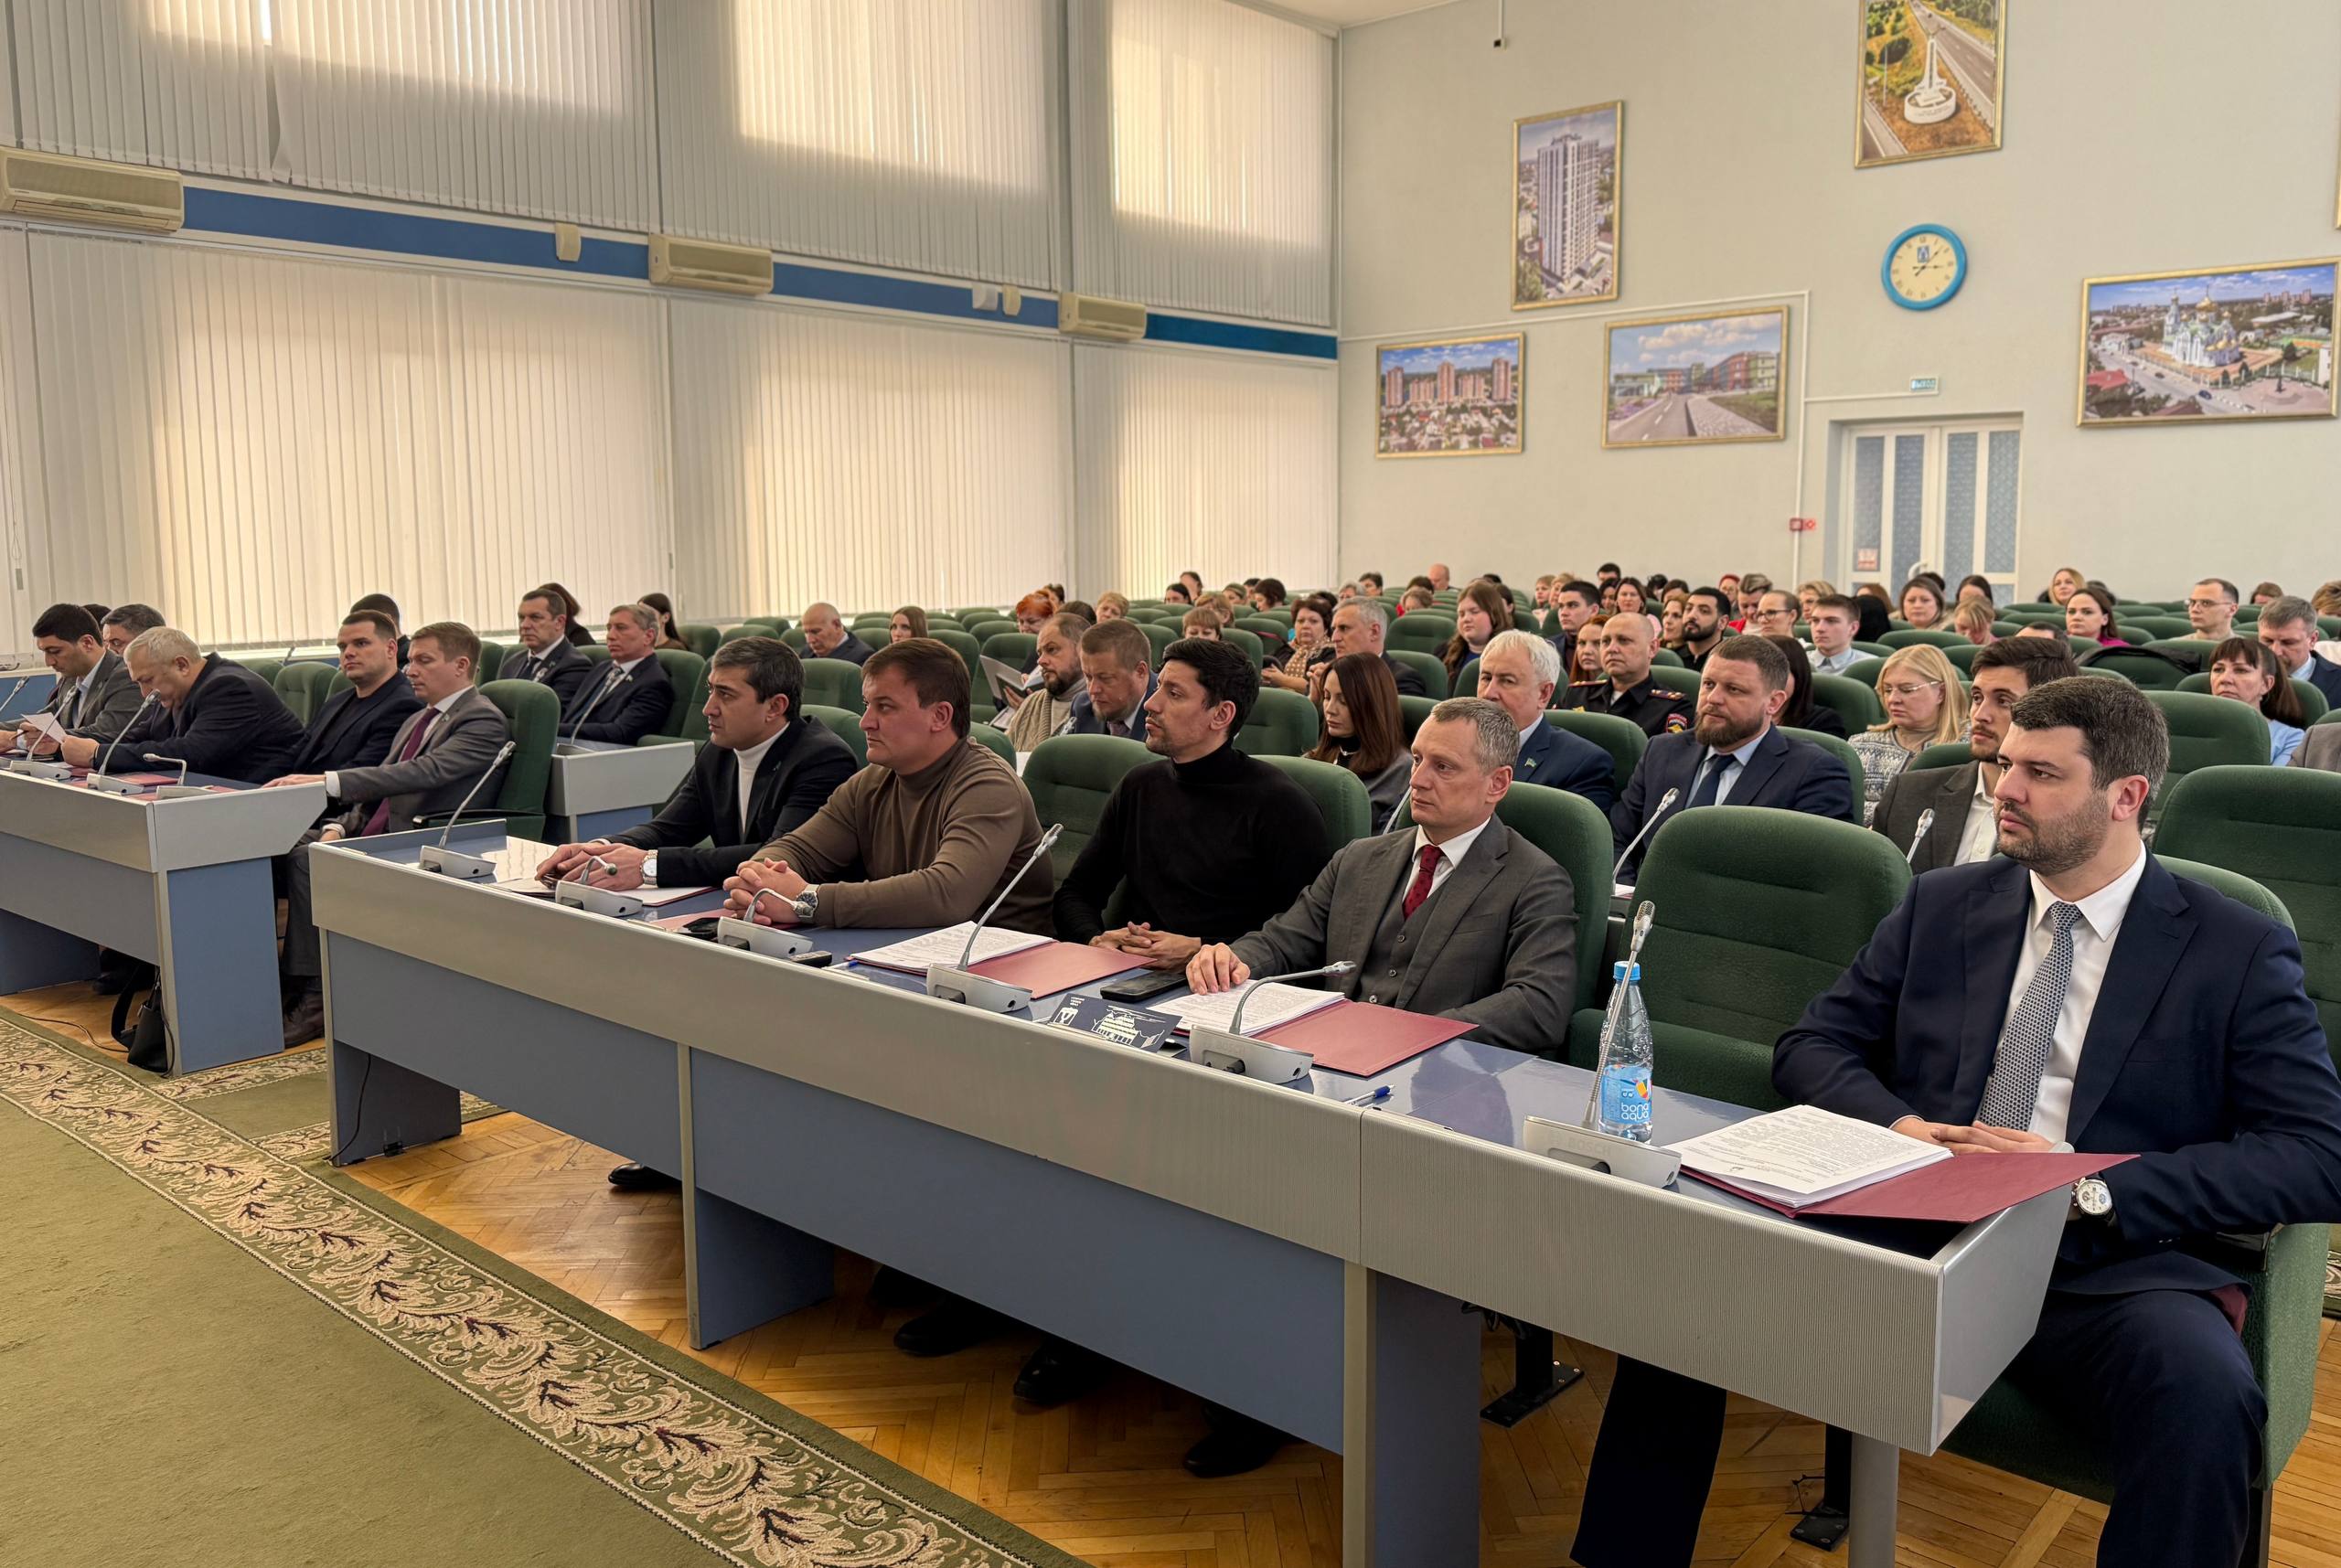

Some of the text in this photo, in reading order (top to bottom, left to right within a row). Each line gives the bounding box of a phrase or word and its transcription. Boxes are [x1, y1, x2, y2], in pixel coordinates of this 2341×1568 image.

[1621, 1102, 1649, 1113] bona
[1621, 1111, 1649, 1122] aqua
[1567, 1137, 1611, 1157] BOSCH
